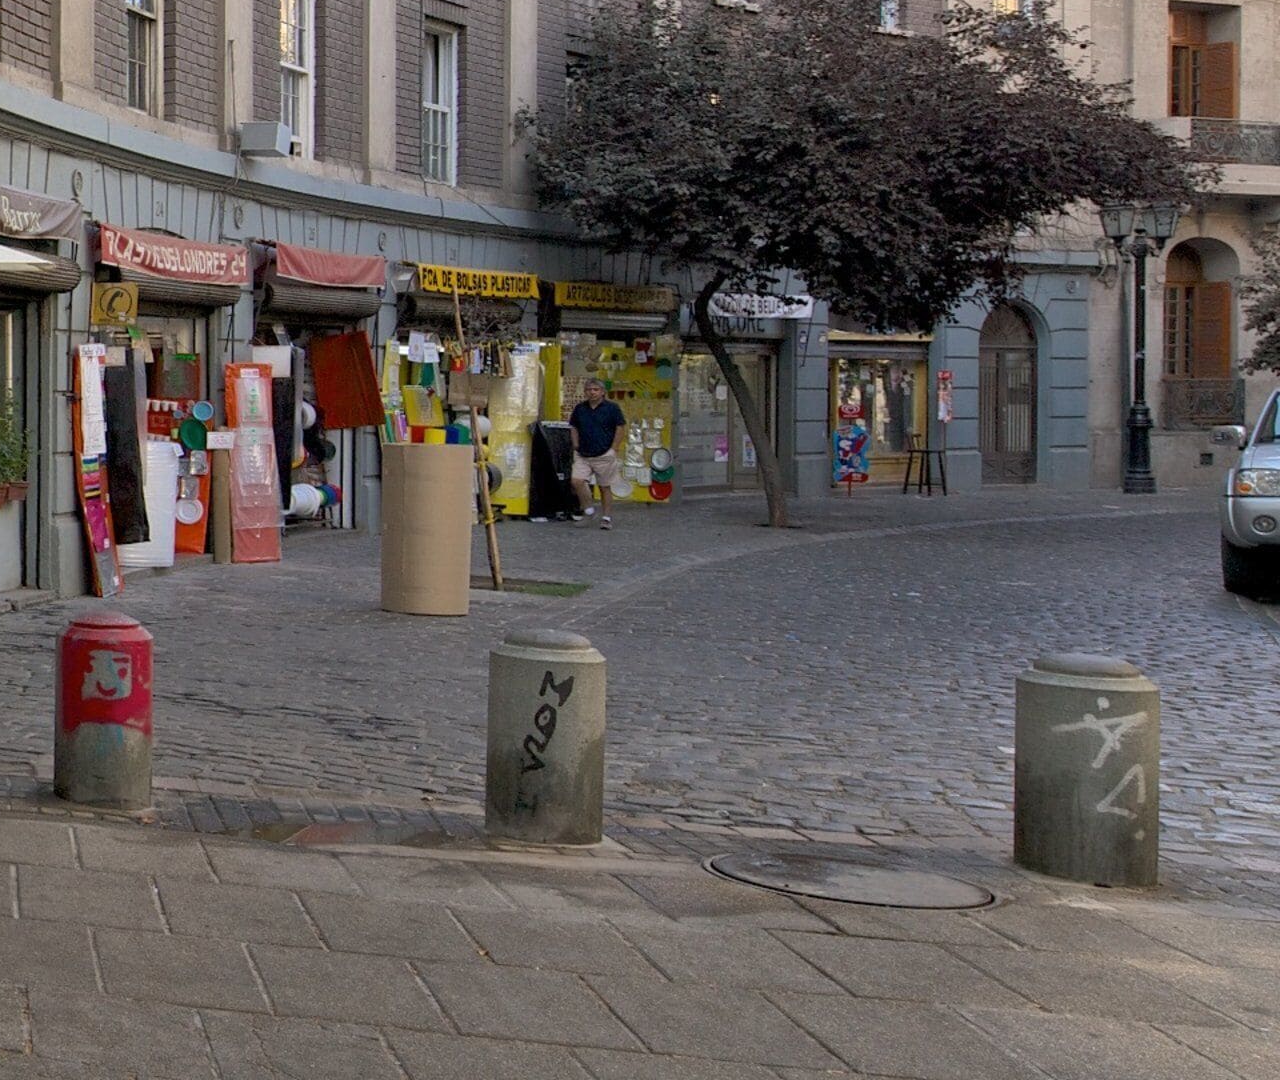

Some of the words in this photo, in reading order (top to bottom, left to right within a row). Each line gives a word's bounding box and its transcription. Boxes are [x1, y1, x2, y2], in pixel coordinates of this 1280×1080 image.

[176, 247, 227, 277] LONDRES
[231, 253, 247, 277] 24
[422, 267, 438, 286] FCA
[442, 270, 452, 288] DE
[456, 271, 488, 291] BOLSAS
[491, 275, 530, 293] PLASTICAS
